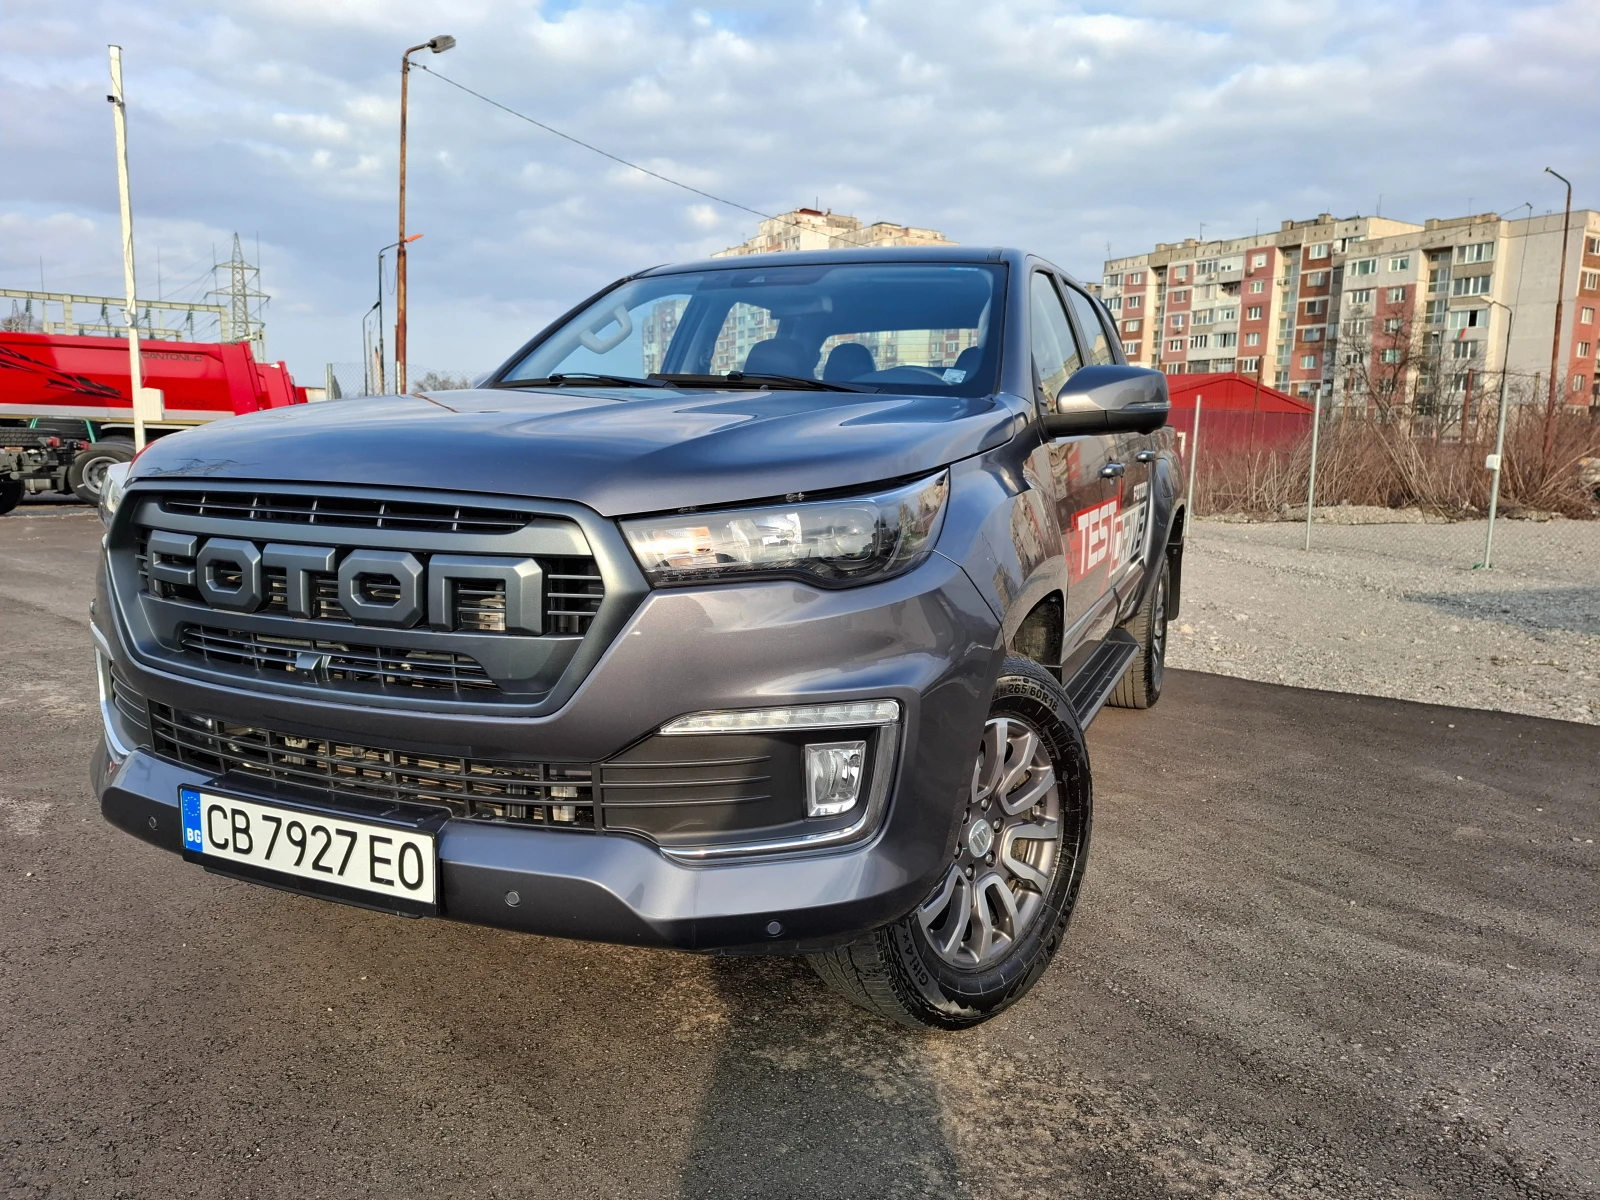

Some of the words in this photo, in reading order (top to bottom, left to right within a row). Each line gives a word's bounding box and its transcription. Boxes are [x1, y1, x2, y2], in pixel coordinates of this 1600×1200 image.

[1078, 500, 1117, 575] TEST
[147, 529, 543, 636] FOTON
[1008, 683, 1059, 712] 265/60R18
[187, 828, 202, 843] BG
[207, 804, 254, 855] CB
[262, 815, 358, 877] 7927
